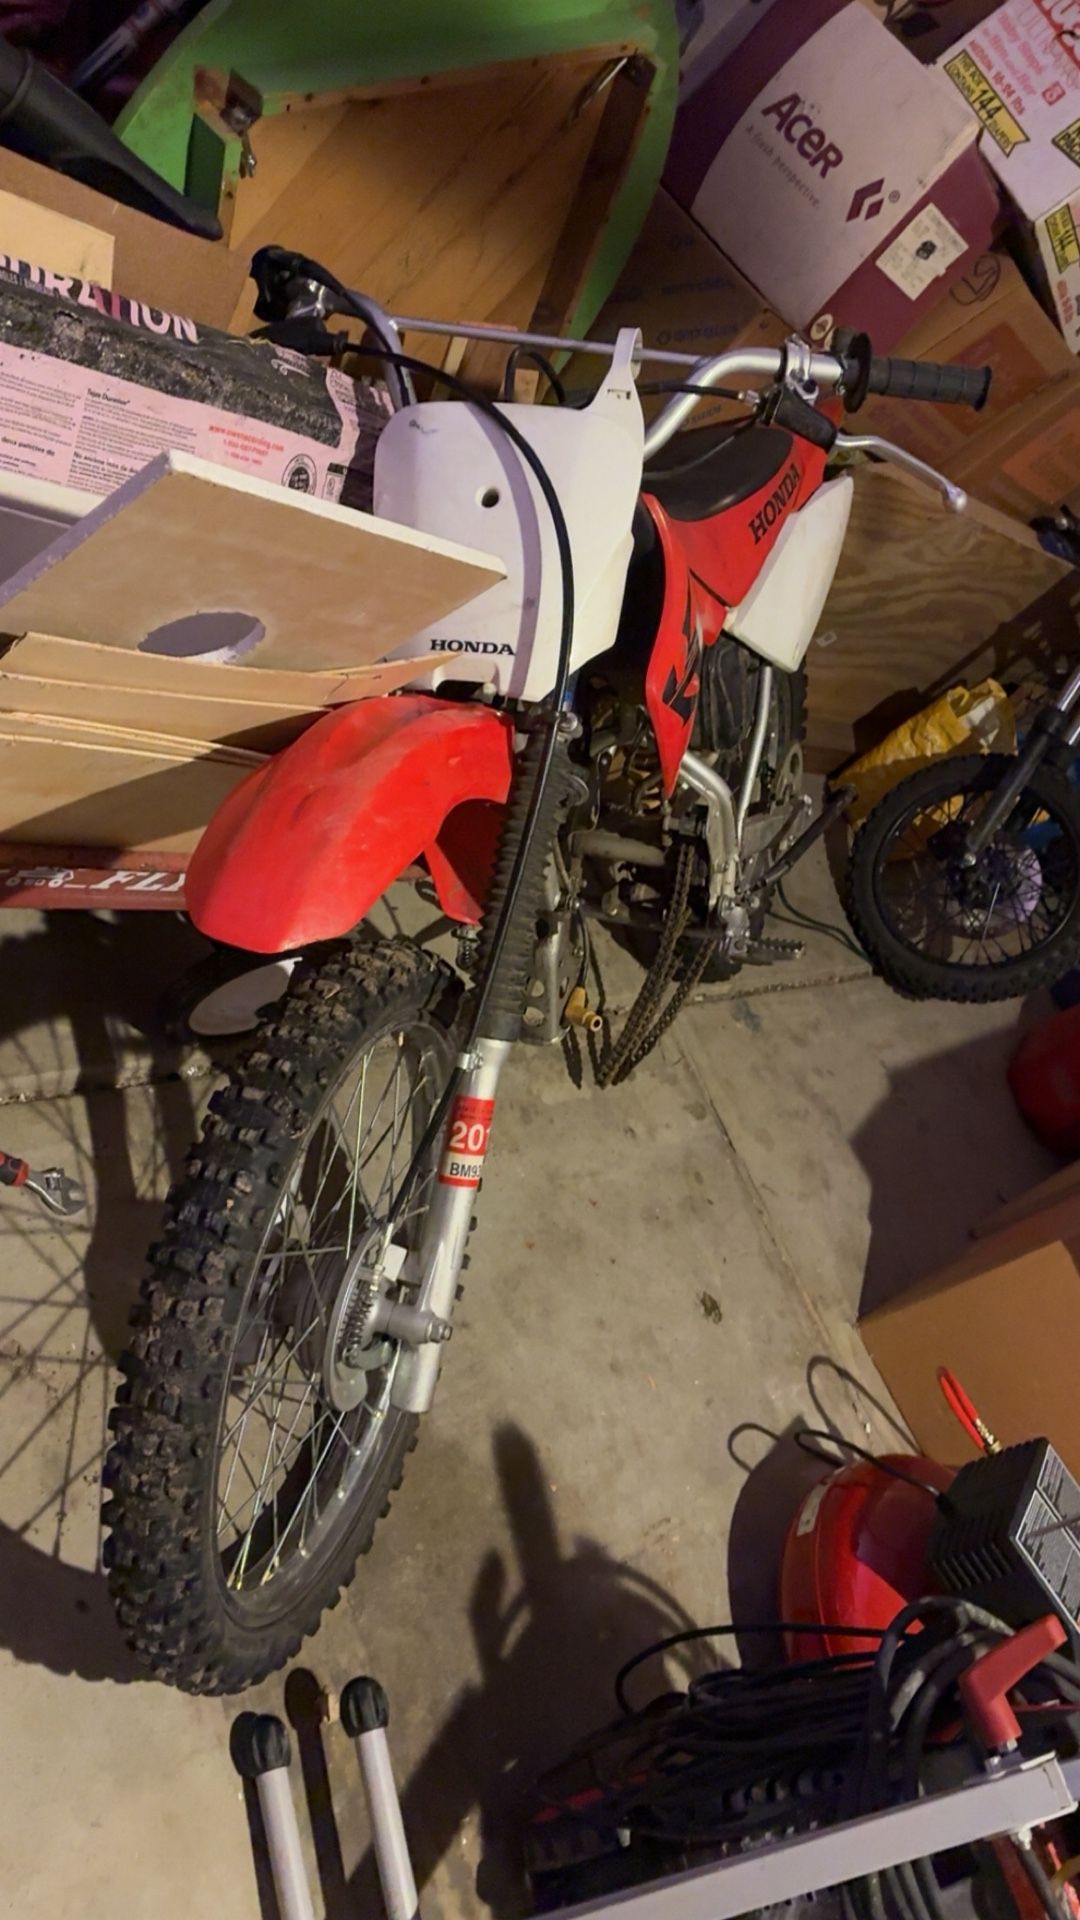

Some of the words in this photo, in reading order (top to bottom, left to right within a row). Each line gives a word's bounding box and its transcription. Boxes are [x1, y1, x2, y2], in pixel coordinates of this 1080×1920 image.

[972, 88, 1003, 120] 144
[748, 463, 800, 545] HONDA
[430, 639, 516, 656] HONDA
[449, 1120, 491, 1152] 20
